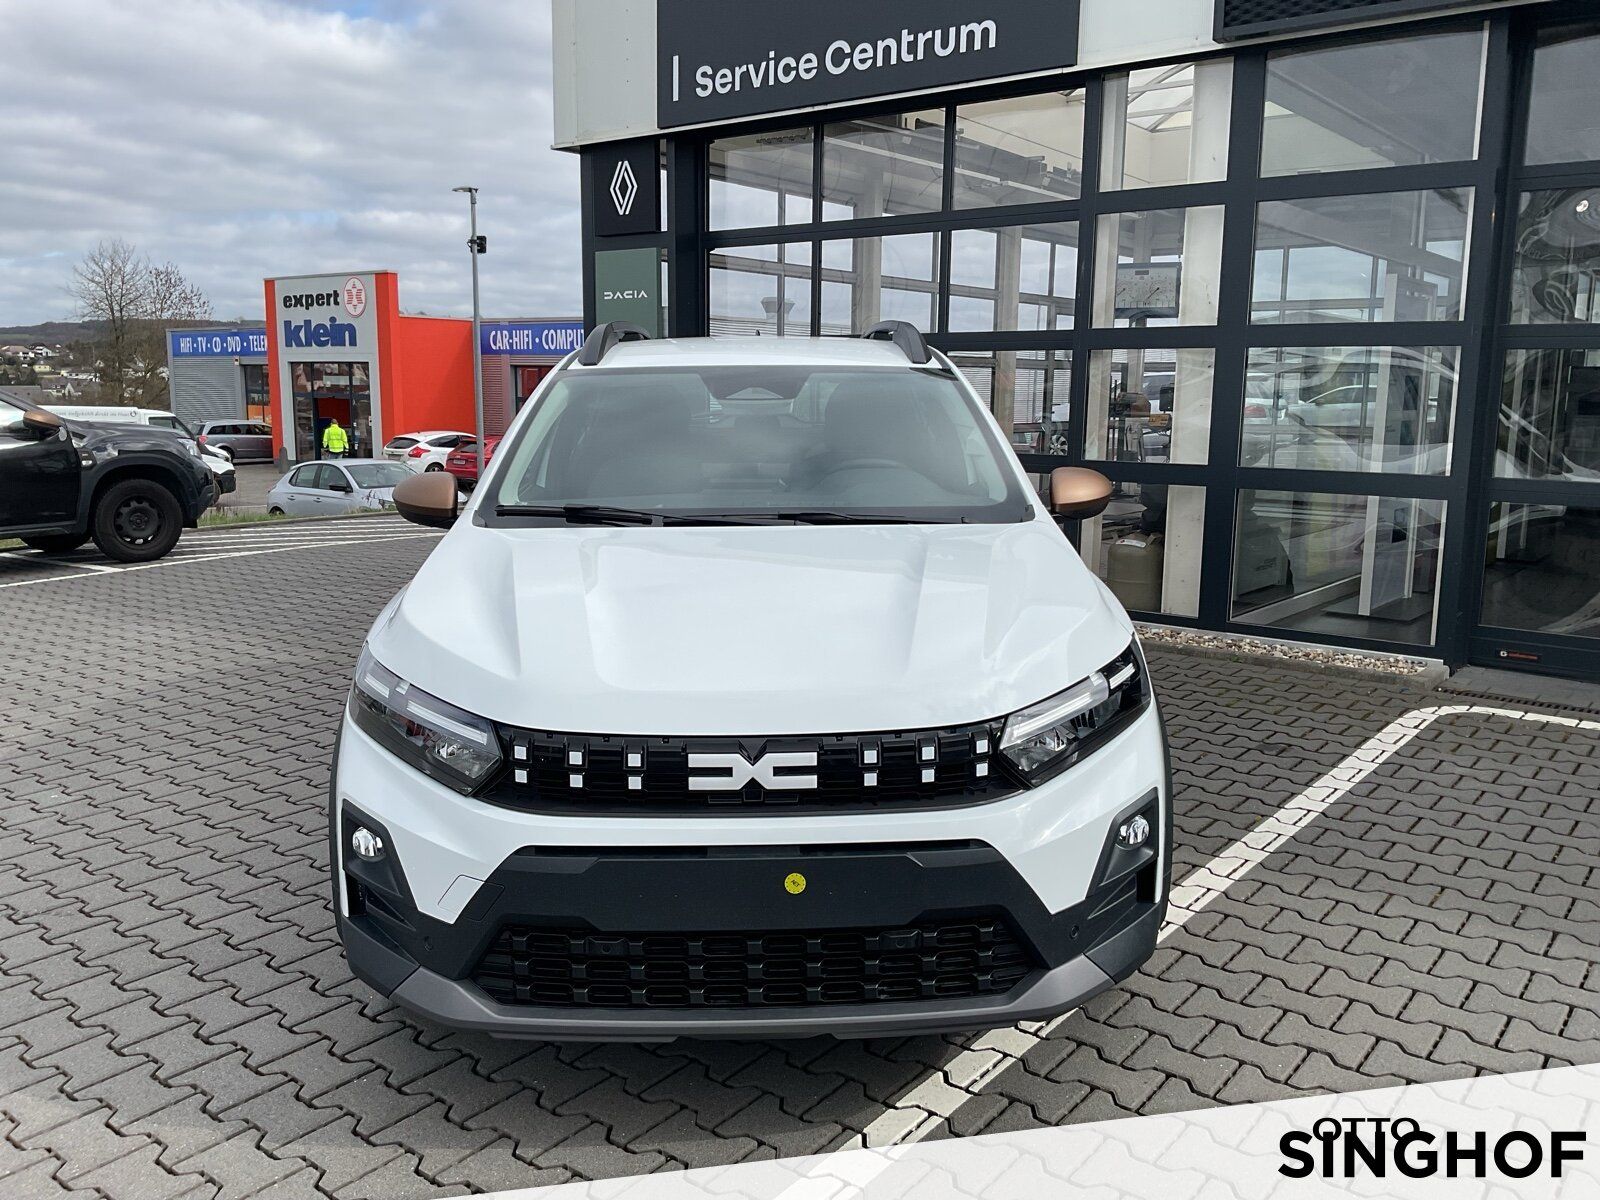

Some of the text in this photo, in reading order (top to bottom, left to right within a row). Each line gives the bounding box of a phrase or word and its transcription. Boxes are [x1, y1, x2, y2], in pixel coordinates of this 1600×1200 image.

[695, 19, 997, 97] Service Centrum
[283, 290, 340, 310] expert
[603, 289, 649, 300] DACIA
[284, 316, 357, 347] klein
[489, 330, 533, 350] CAR-HIFI
[180, 337, 193, 353] HIFI
[197, 336, 207, 353] TV
[212, 336, 221, 353] CD
[227, 335, 241, 353] DVD
